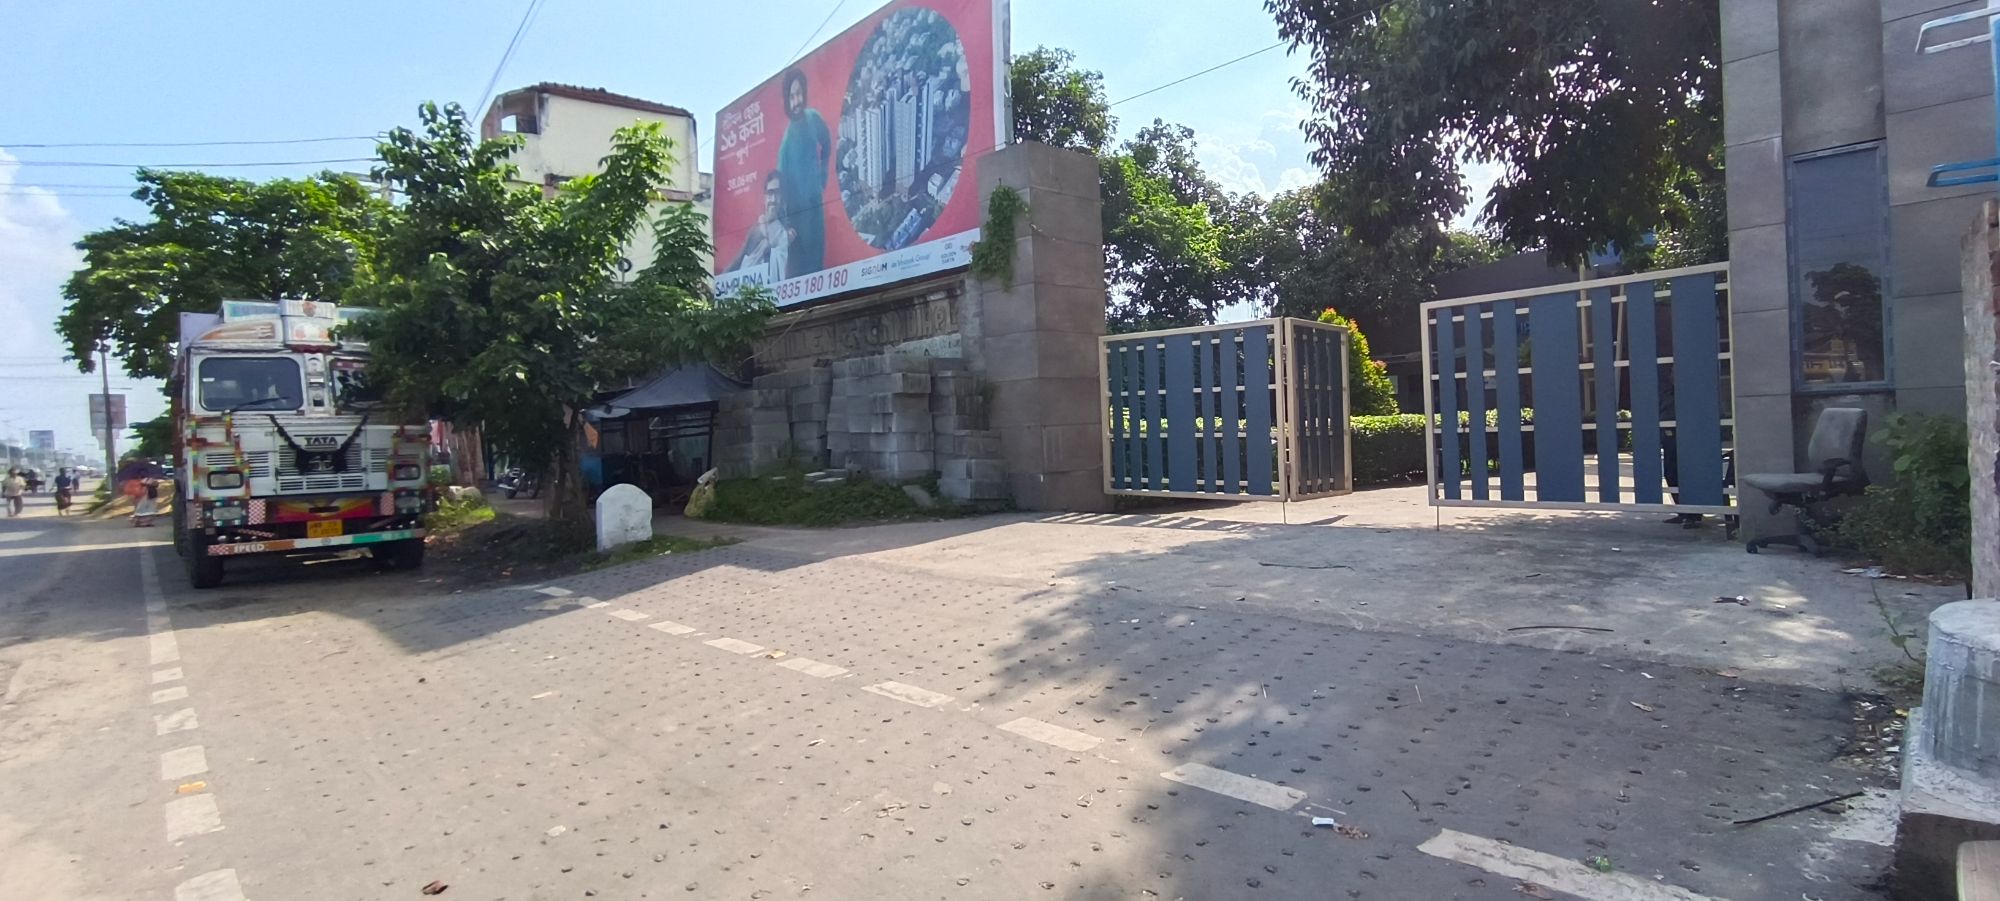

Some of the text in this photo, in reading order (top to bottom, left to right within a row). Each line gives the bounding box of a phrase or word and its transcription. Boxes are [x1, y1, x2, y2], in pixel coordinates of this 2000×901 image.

[739, 111, 764, 141] কলা
[804, 275, 824, 296] 180
[828, 268, 848, 290] 180
[304, 436, 338, 446] TATA
[234, 543, 265, 553] SPEED
